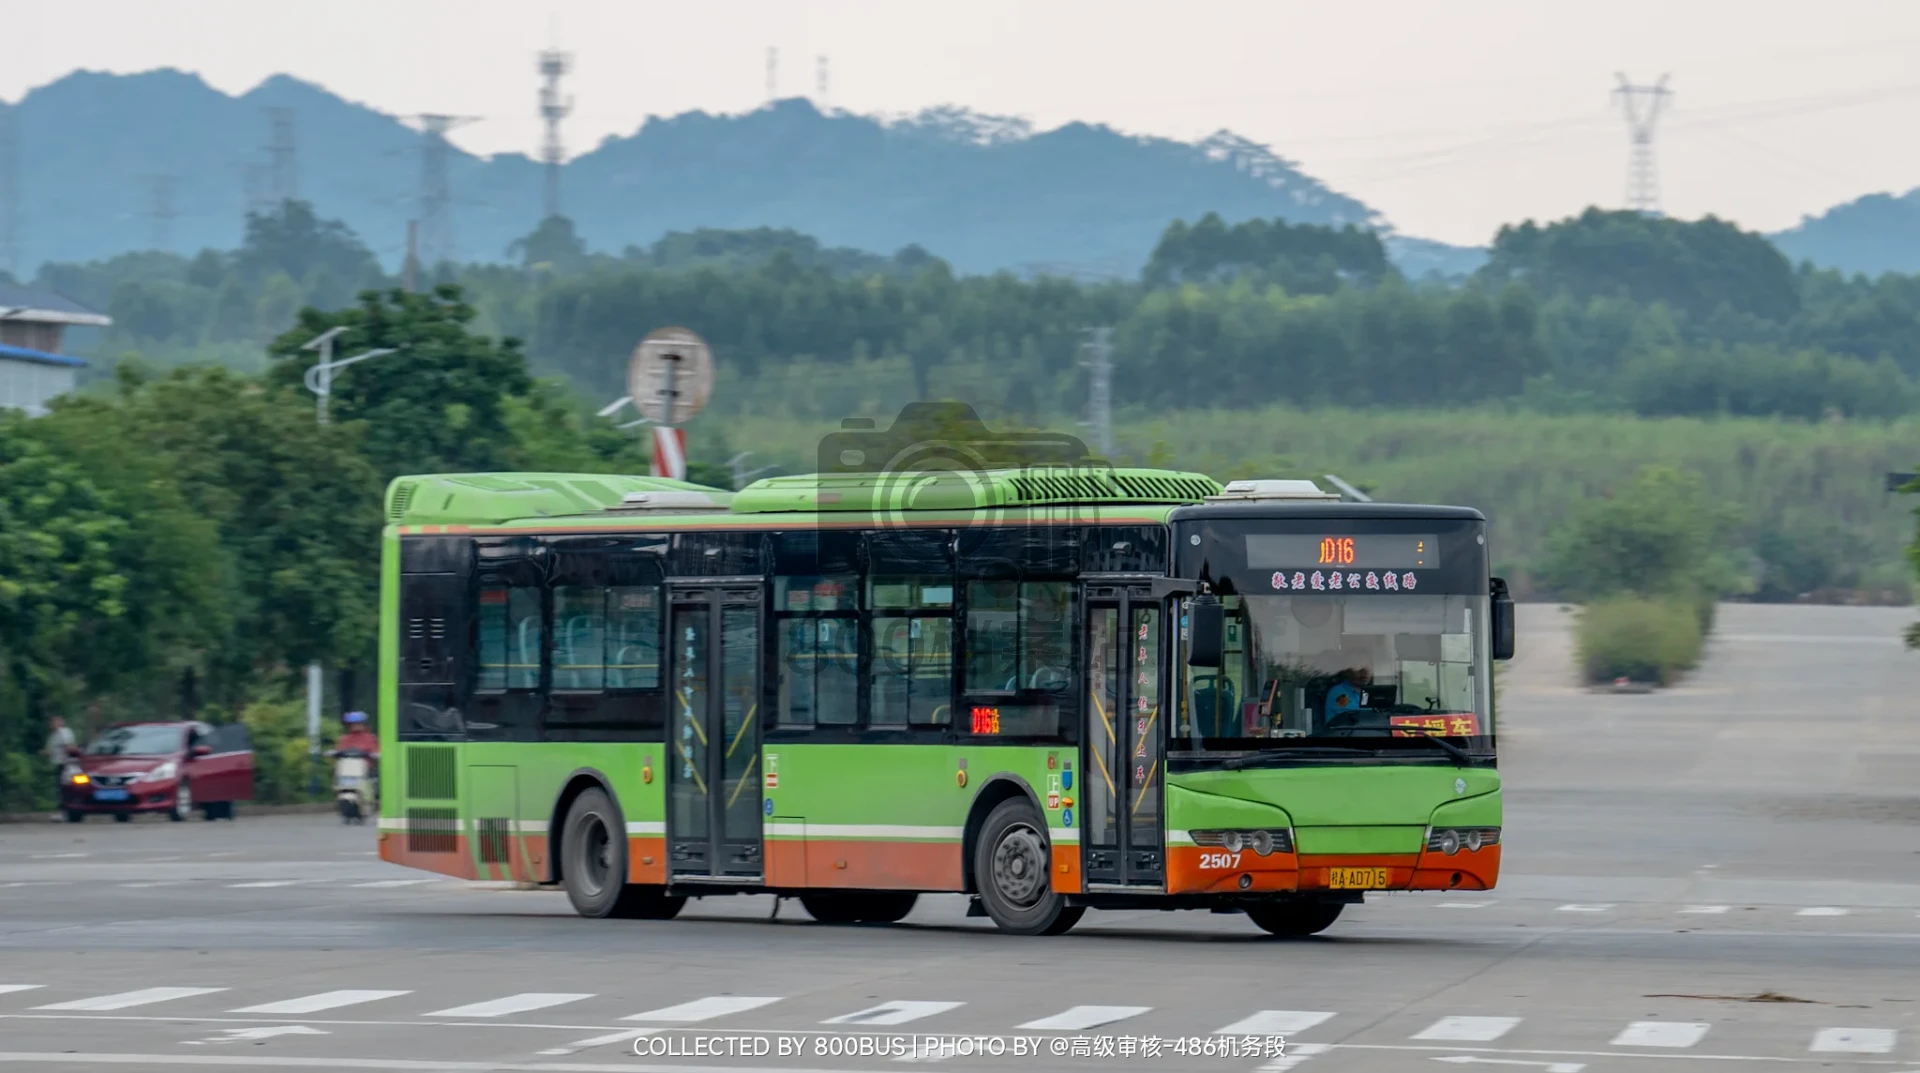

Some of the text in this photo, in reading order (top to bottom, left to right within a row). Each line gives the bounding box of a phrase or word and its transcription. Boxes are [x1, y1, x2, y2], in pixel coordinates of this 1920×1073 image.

[1271, 570, 1417, 591] 敬老爱老公交线路
[1199, 854, 1241, 869] 2507
